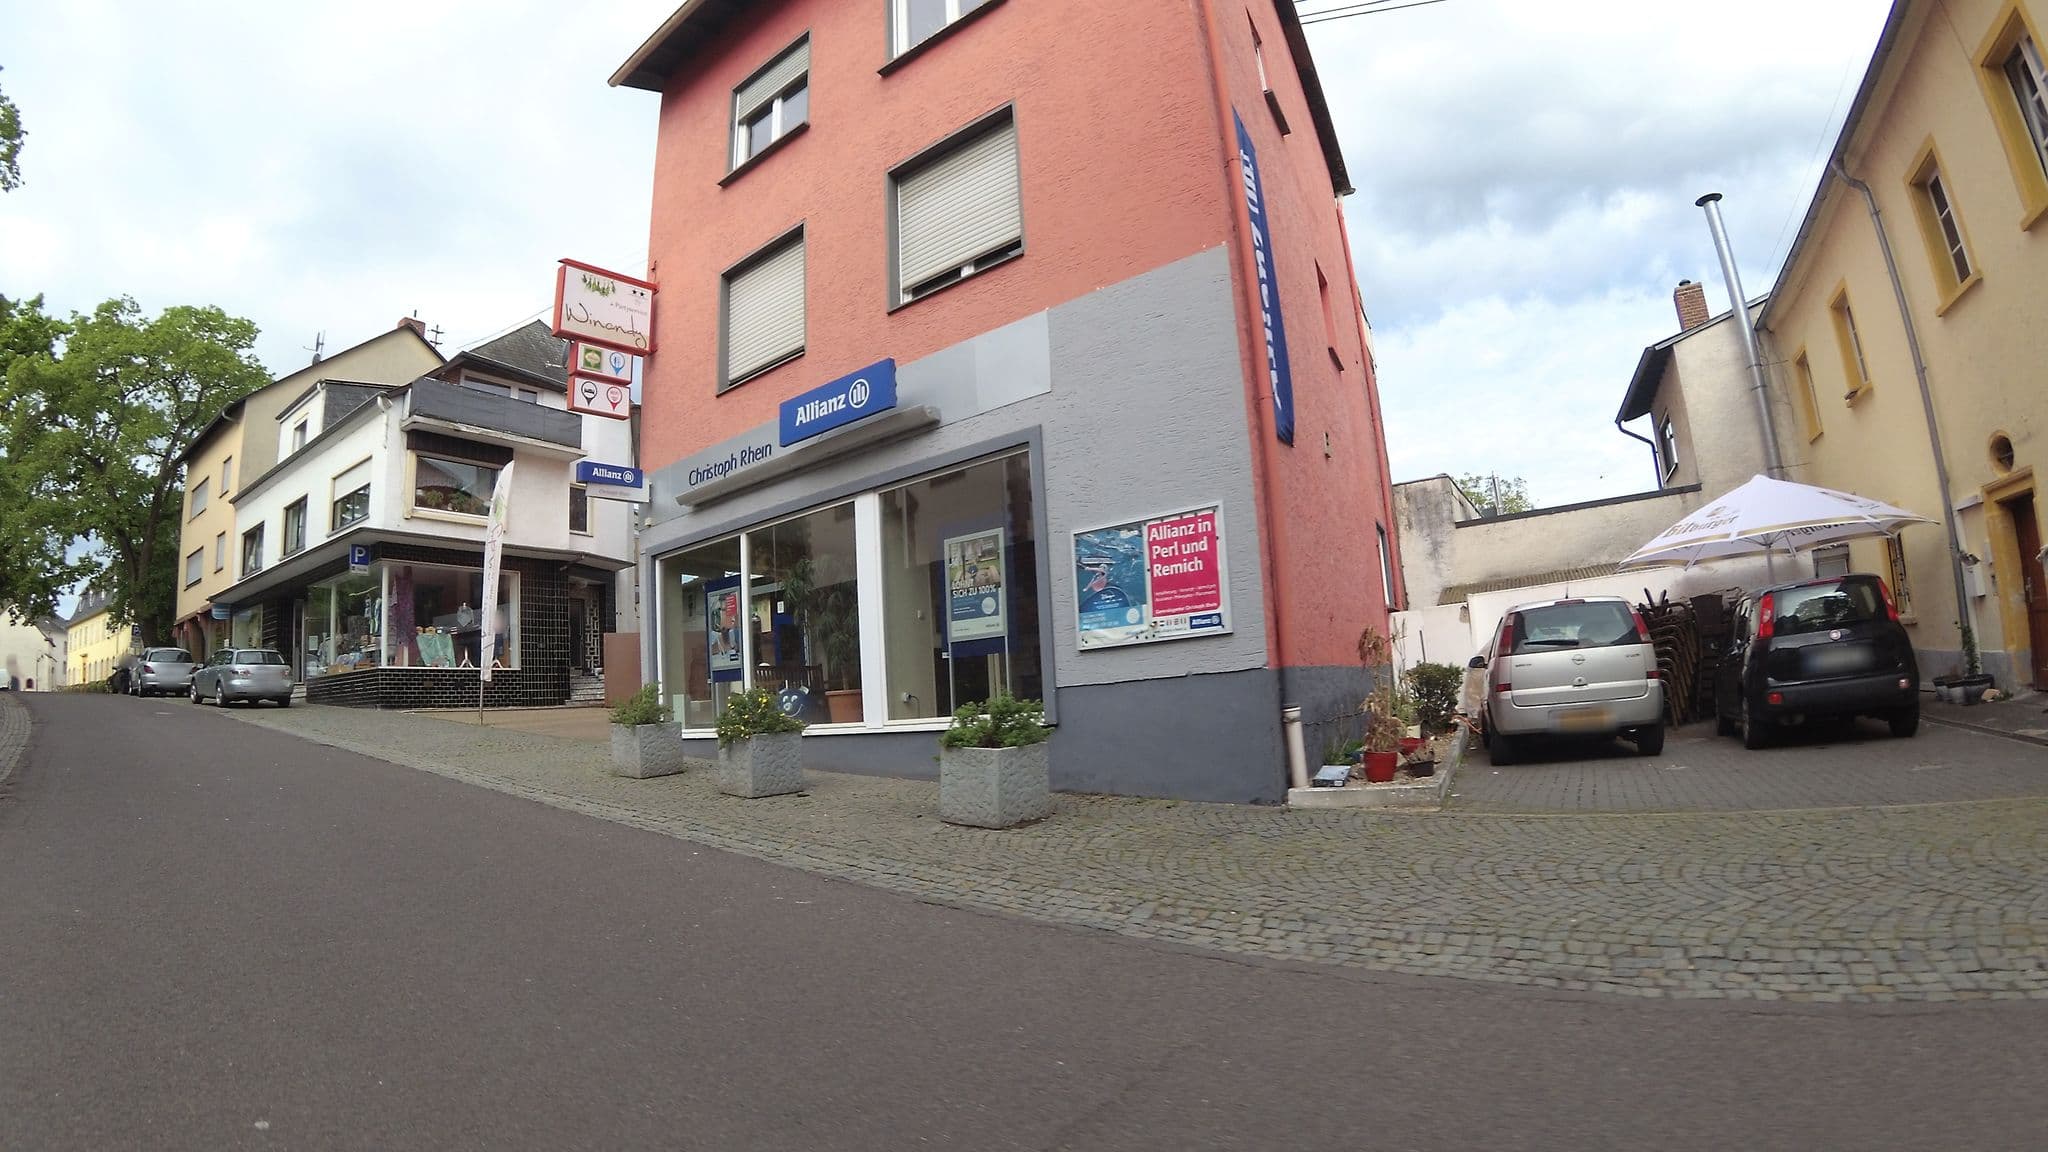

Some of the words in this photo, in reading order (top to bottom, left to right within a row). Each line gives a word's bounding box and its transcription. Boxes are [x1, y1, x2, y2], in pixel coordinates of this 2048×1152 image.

[565, 303, 647, 349] Winandy
[795, 392, 847, 427] Allianz
[592, 467, 622, 480] Allianz
[688, 453, 737, 486] Christoph
[740, 443, 772, 467] Rhein
[1149, 523, 1196, 542] Allianz
[1198, 519, 1212, 533] in
[354, 546, 366, 563] P
[1152, 543, 1179, 560] Perl
[1181, 538, 1208, 553] und
[1153, 556, 1203, 578] Remich
